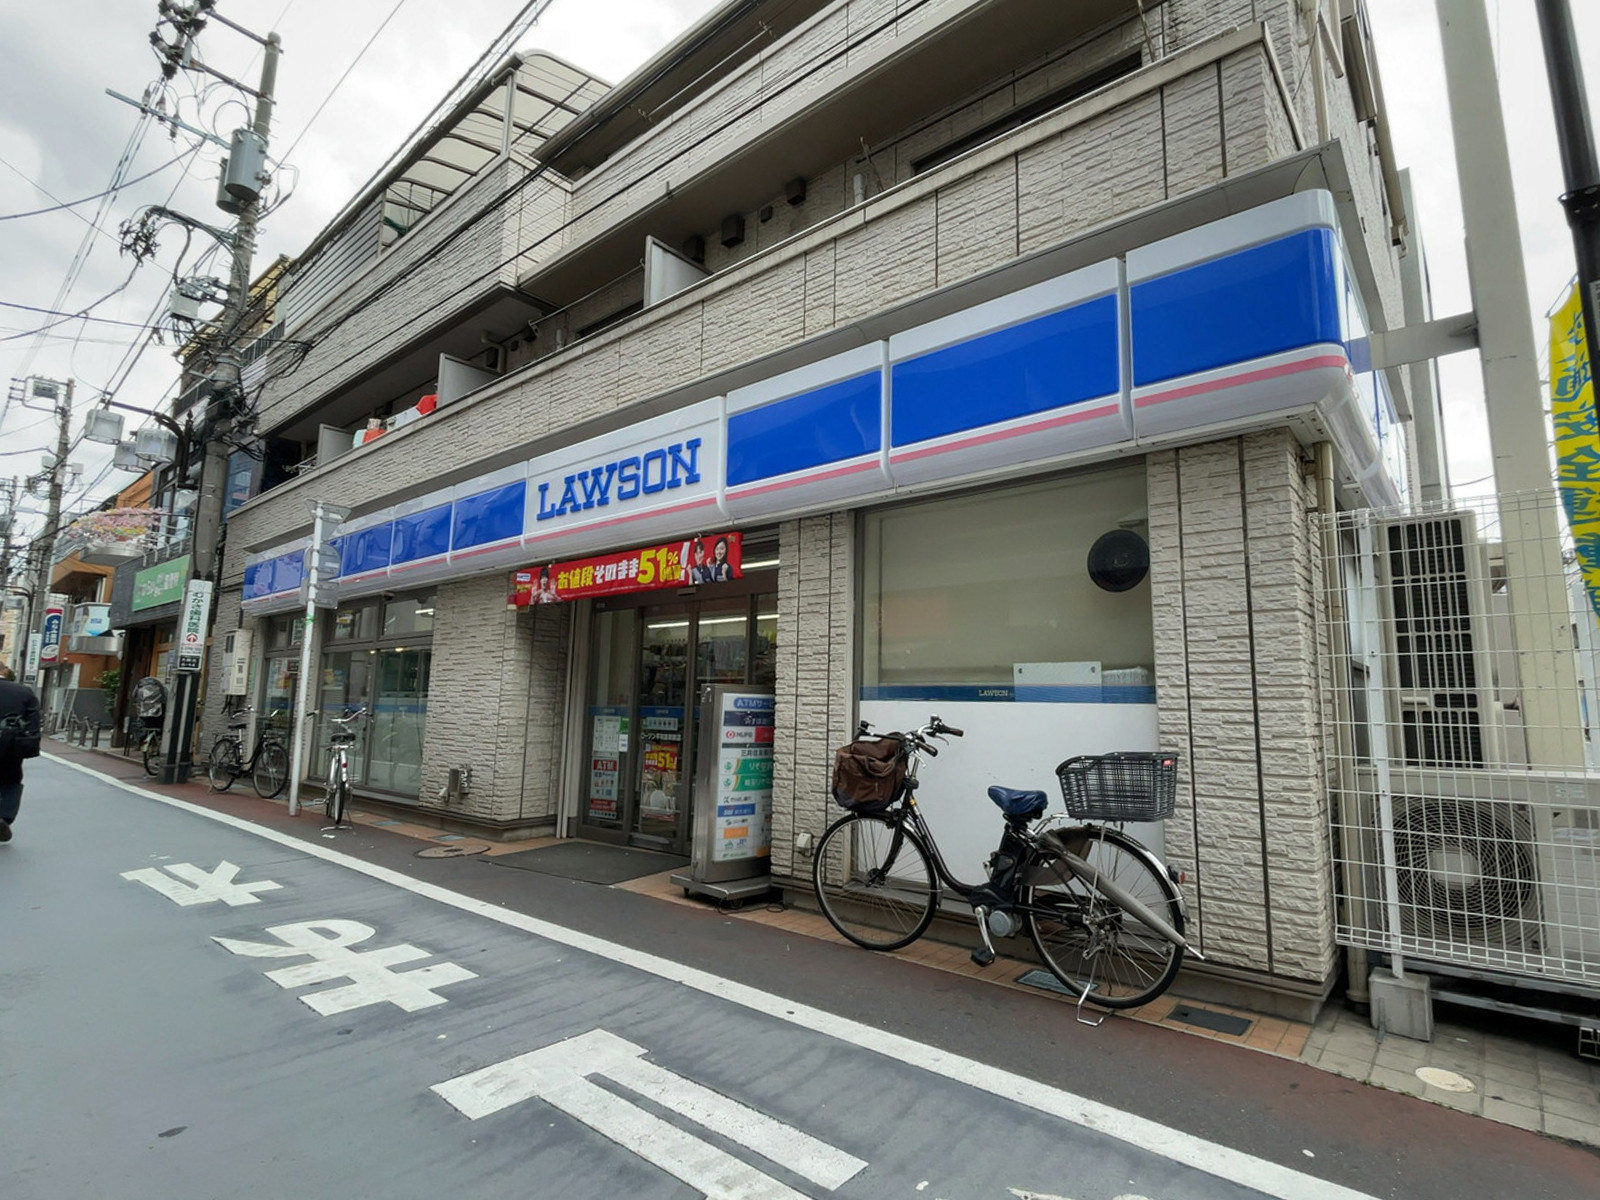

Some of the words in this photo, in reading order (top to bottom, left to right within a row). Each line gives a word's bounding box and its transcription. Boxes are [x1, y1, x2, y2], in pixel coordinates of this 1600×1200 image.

[536, 437, 702, 521] LAWSON
[978, 689, 1008, 697] LAWSON
[596, 761, 614, 770] ATM
[120, 860, 869, 1200] 止まれ
